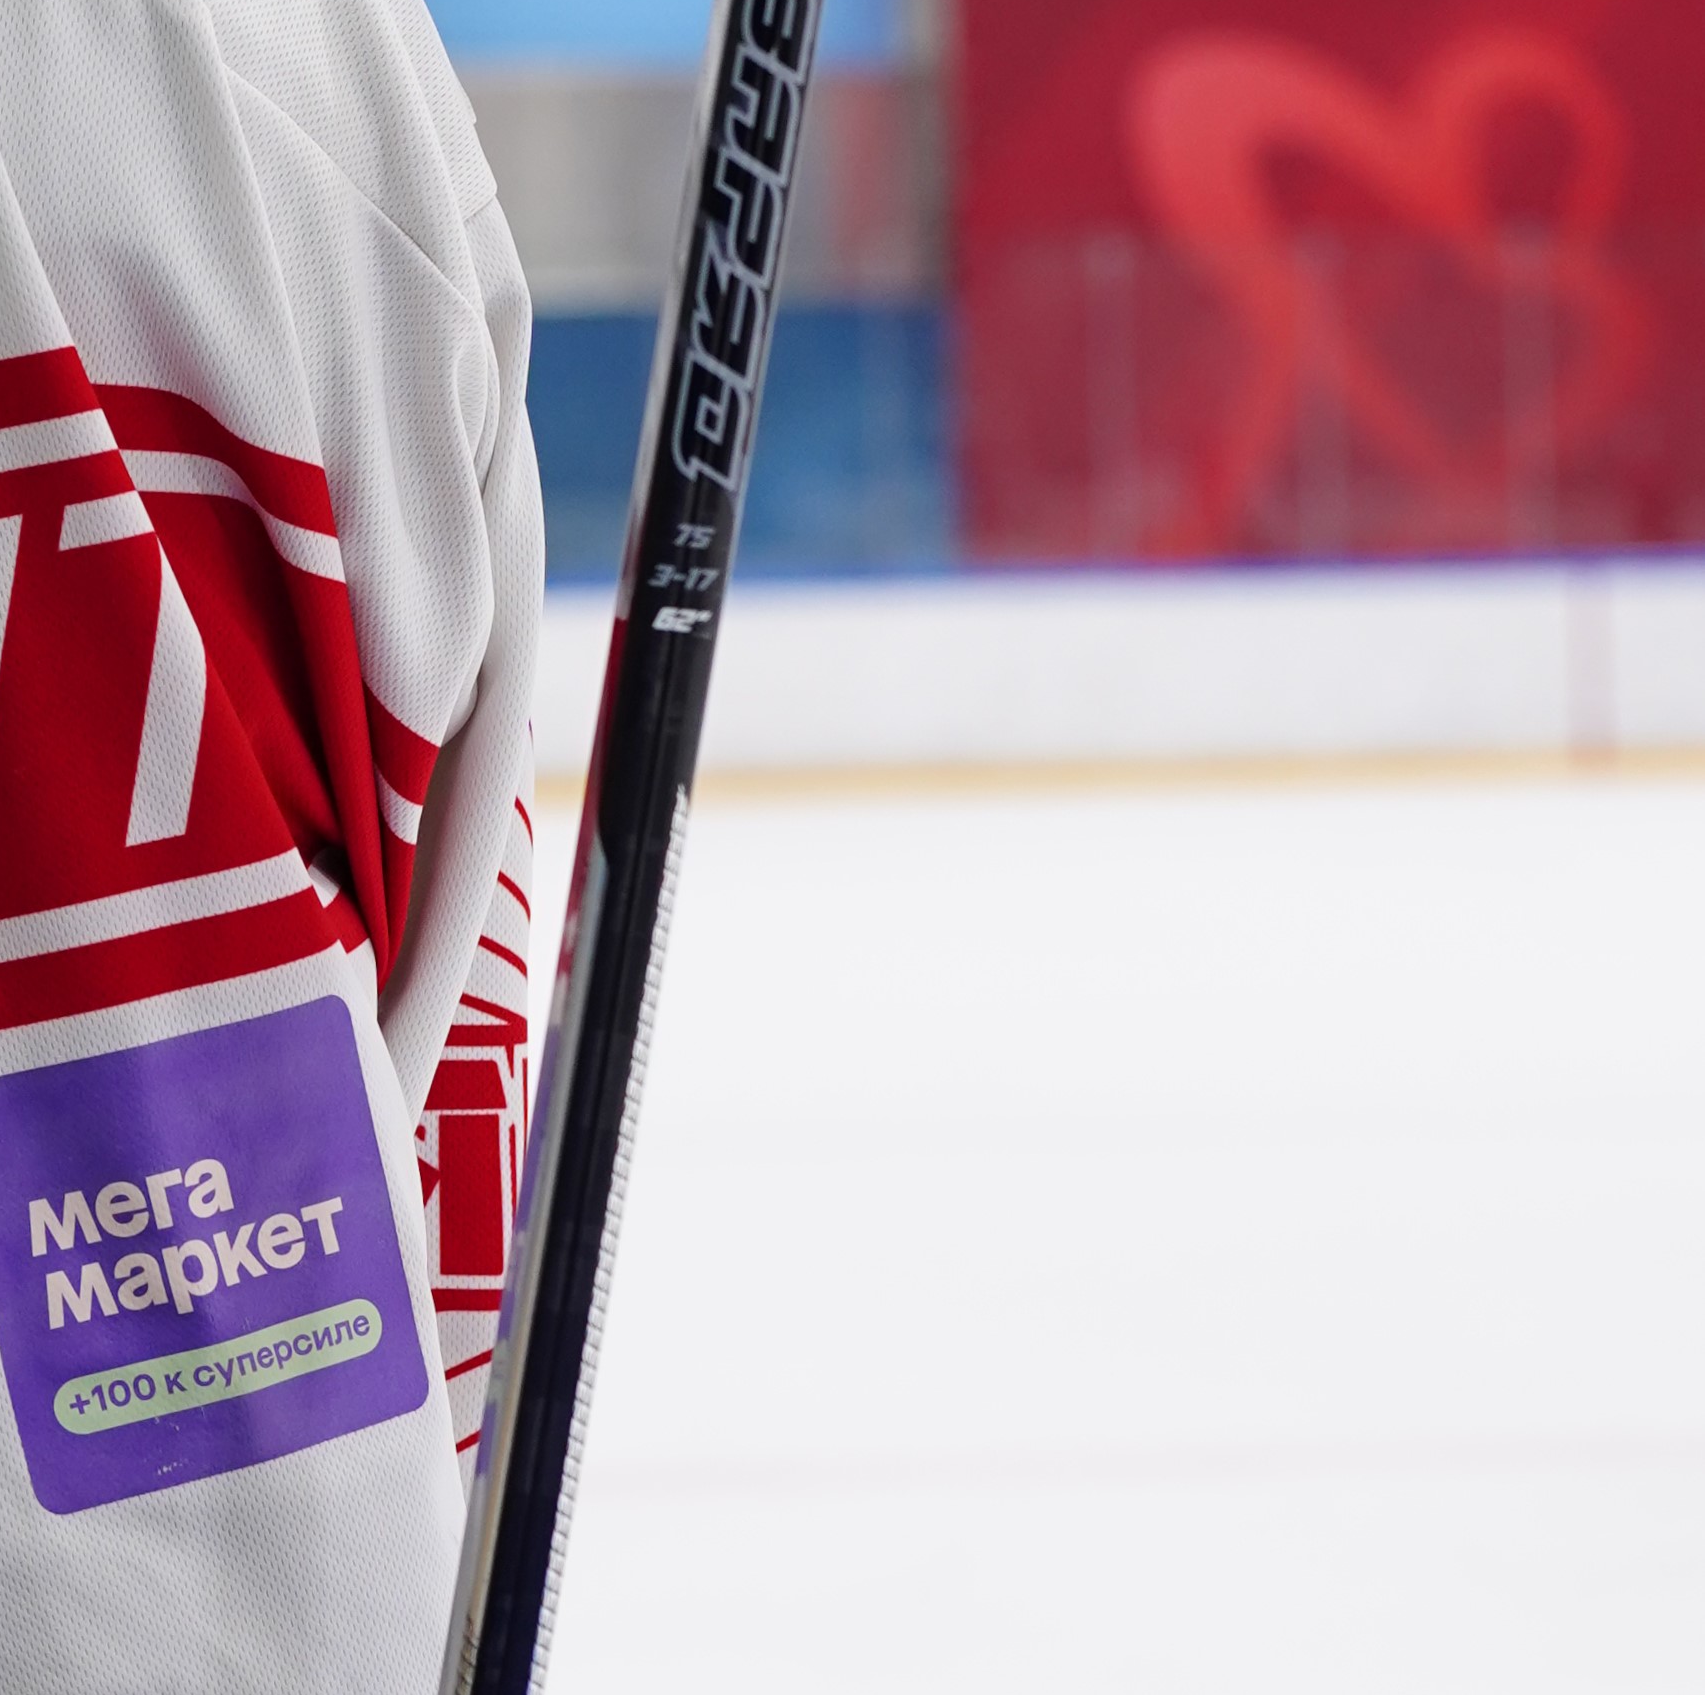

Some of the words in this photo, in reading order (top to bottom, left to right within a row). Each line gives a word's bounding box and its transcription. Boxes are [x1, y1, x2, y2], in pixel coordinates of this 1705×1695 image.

[28, 1158, 235, 1258] мега
[45, 1196, 344, 1331] маркет
[68, 1372, 157, 1416] +100
[165, 1369, 189, 1396] к
[192, 1313, 372, 1389] суперсиле
